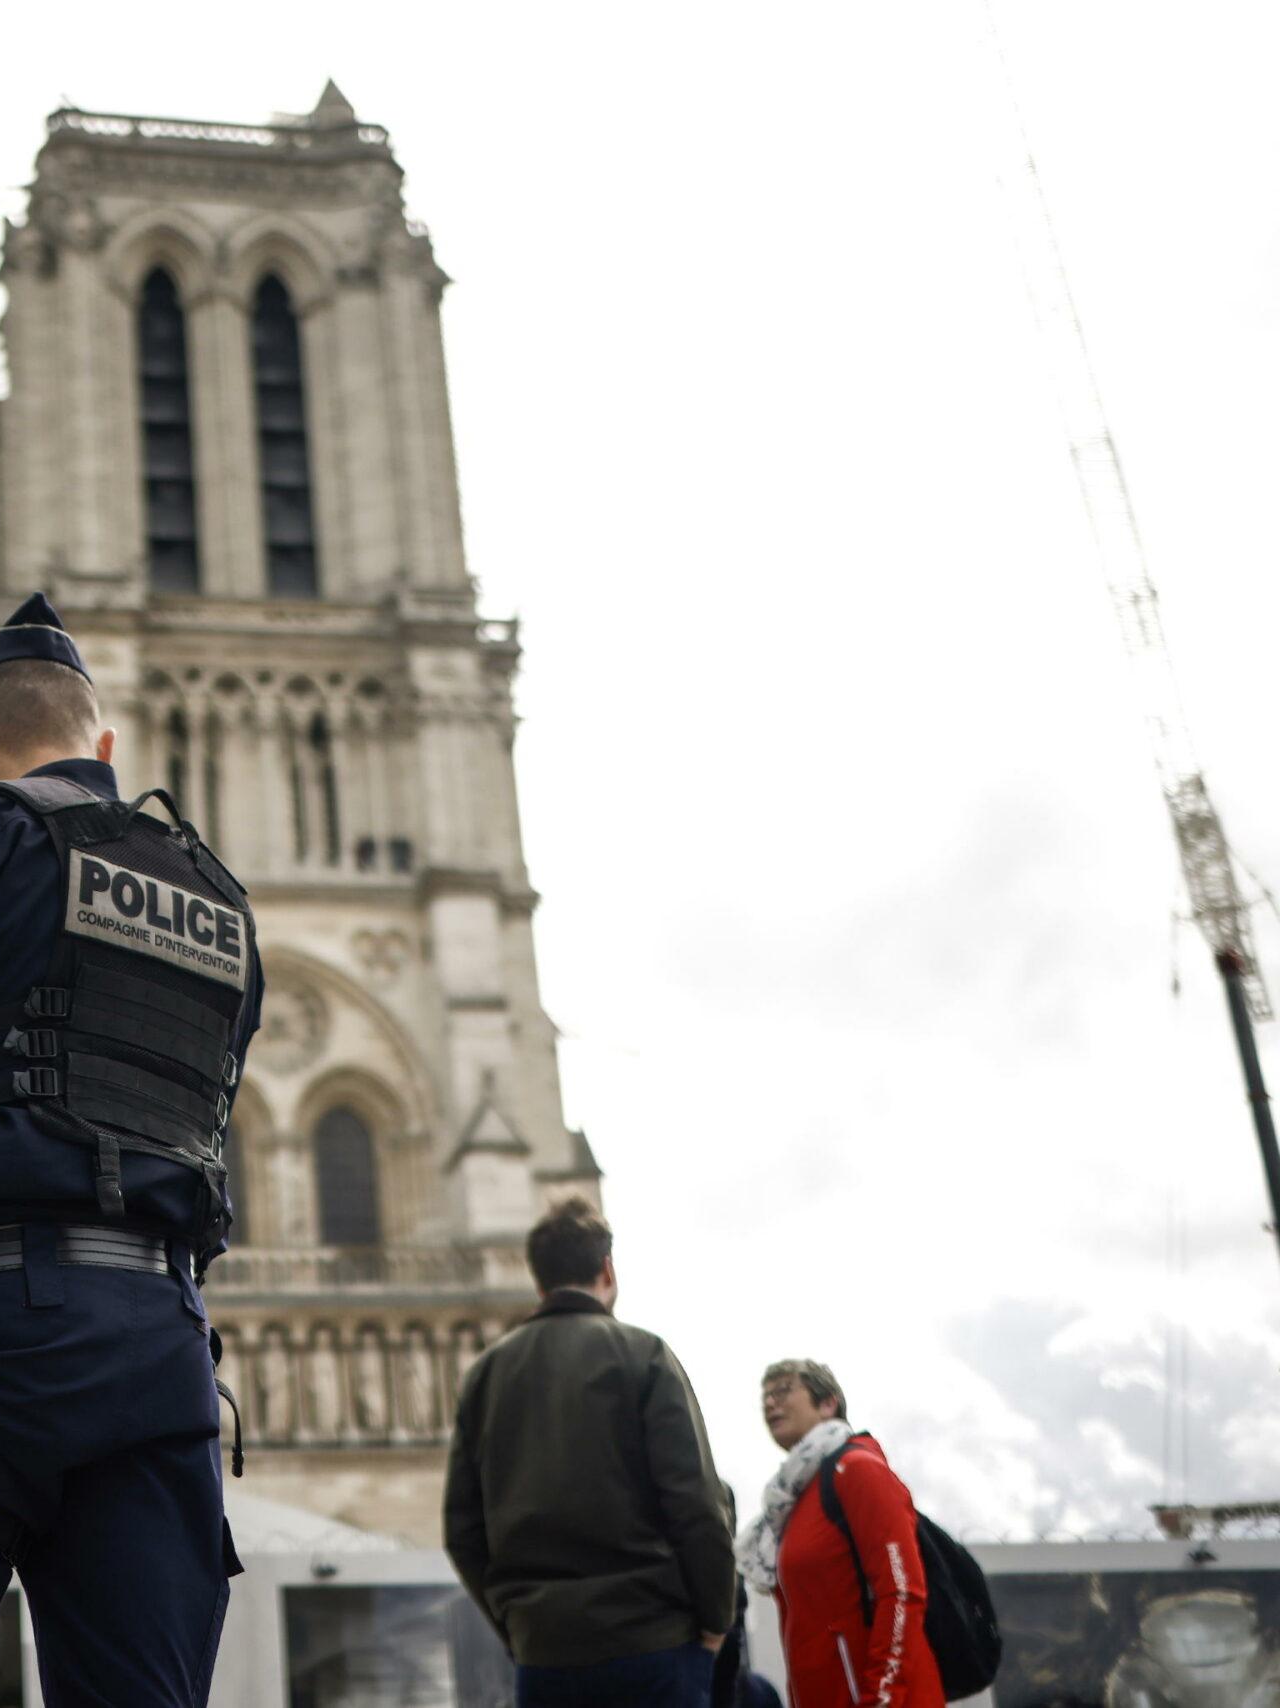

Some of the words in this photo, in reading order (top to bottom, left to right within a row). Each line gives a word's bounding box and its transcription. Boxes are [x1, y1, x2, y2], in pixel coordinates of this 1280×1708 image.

[77, 910, 150, 943] COMPAGNIE
[154, 934, 239, 976] D'INTERVENTION
[79, 858, 241, 959] POLICE
